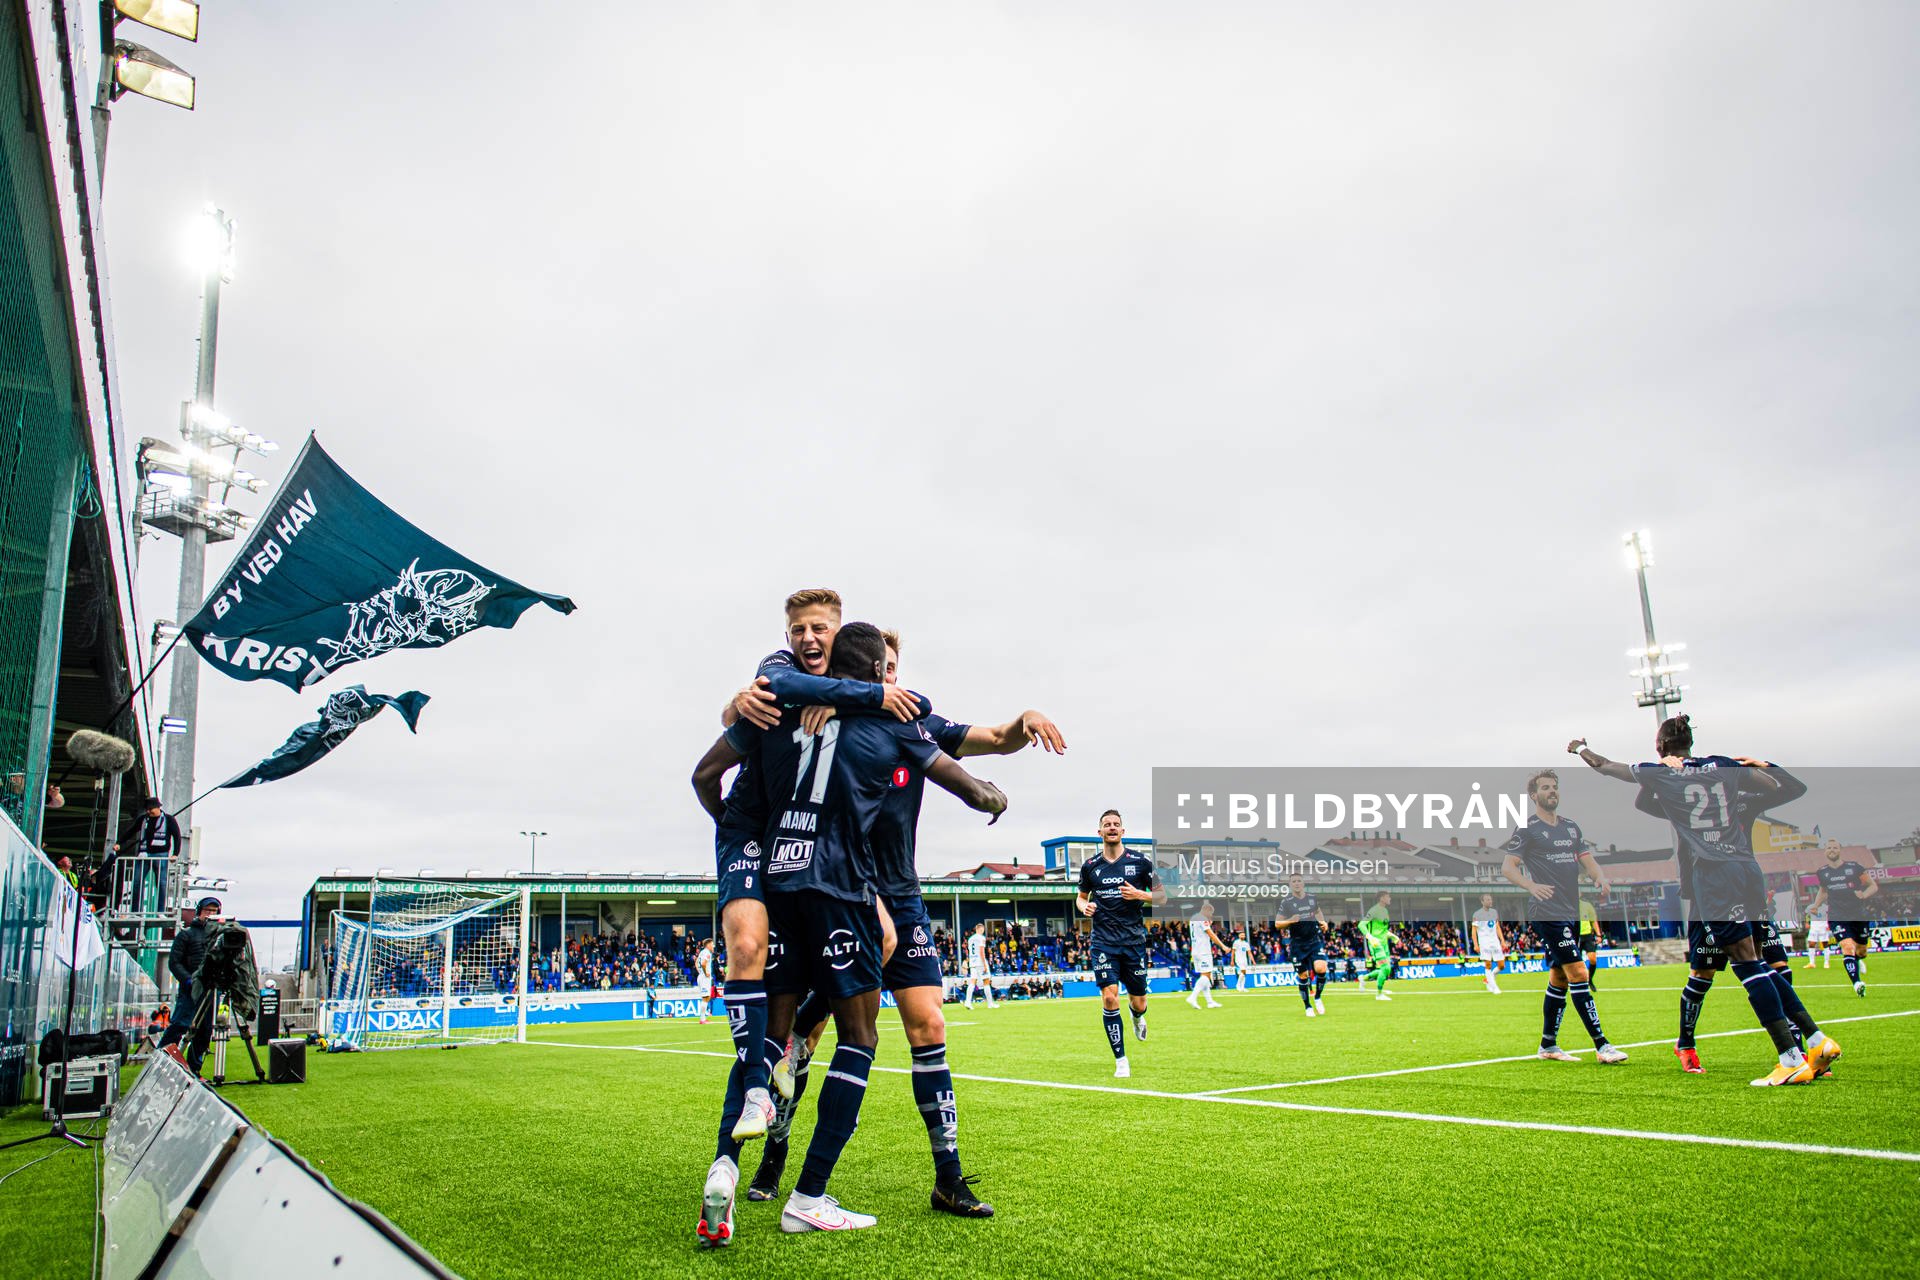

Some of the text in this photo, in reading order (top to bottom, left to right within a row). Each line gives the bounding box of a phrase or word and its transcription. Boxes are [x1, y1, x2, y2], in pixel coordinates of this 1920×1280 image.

[213, 489, 320, 620] BY VED HAV
[792, 720, 840, 804] 11
[1684, 781, 1730, 829] 21
[780, 811, 817, 832] MAWA
[1703, 831, 1721, 842] DIOP
[776, 841, 814, 861] MOT
[545, 884, 571, 893] notar
[576, 884, 601, 893] notar
[604, 884, 630, 893] notar
[633, 884, 657, 893] notar
[661, 884, 685, 893] notar
[688, 884, 712, 893] notar
[822, 941, 860, 957] ALTI
[1254, 972, 1299, 987] LINDBAK
[936, 1090, 958, 1138] NEAS
